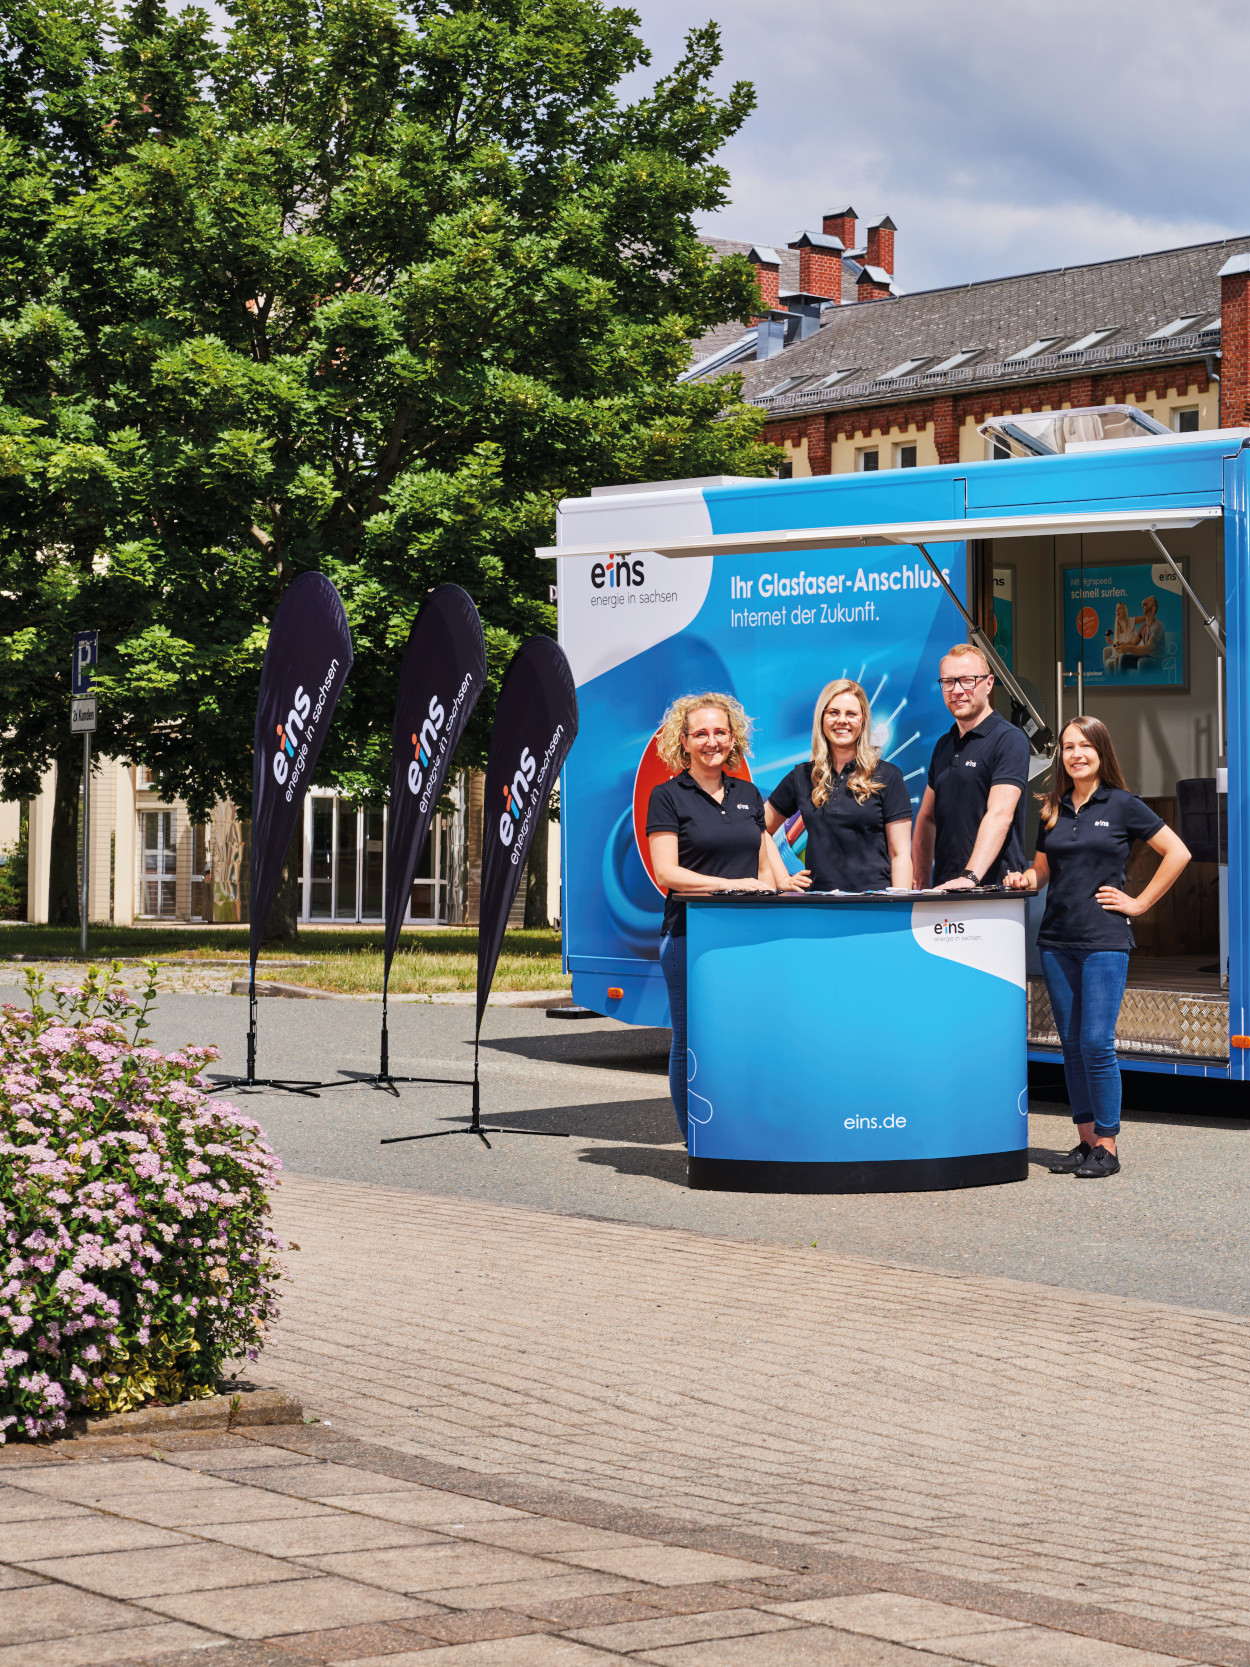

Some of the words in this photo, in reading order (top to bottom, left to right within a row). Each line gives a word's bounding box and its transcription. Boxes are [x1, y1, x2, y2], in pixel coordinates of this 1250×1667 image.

[590, 553, 645, 588] eins
[731, 575, 753, 599] Ihr
[758, 564, 951, 598] Glasfaser-Anschluss
[1159, 571, 1177, 581] eins
[590, 593, 625, 608] energie
[628, 592, 636, 604] in
[639, 589, 678, 604] sachsen
[1070, 588, 1099, 599] schnell
[1101, 587, 1128, 598] surfen.
[731, 606, 786, 628] Internet
[791, 605, 817, 625] der
[820, 601, 880, 624] Zukunft.
[77, 640, 91, 687] P
[285, 743, 309, 803] energie
[304, 725, 315, 742] in
[312, 658, 340, 723] sachsen
[438, 736, 448, 754] in
[445, 672, 473, 735] sachsen
[273, 685, 311, 785] eins
[407, 695, 445, 795] eins
[530, 788, 540, 806] in
[537, 724, 564, 786] sachsen
[500, 746, 537, 847] eins
[933, 918, 965, 935] eins
[843, 1112, 907, 1130] eins.de
